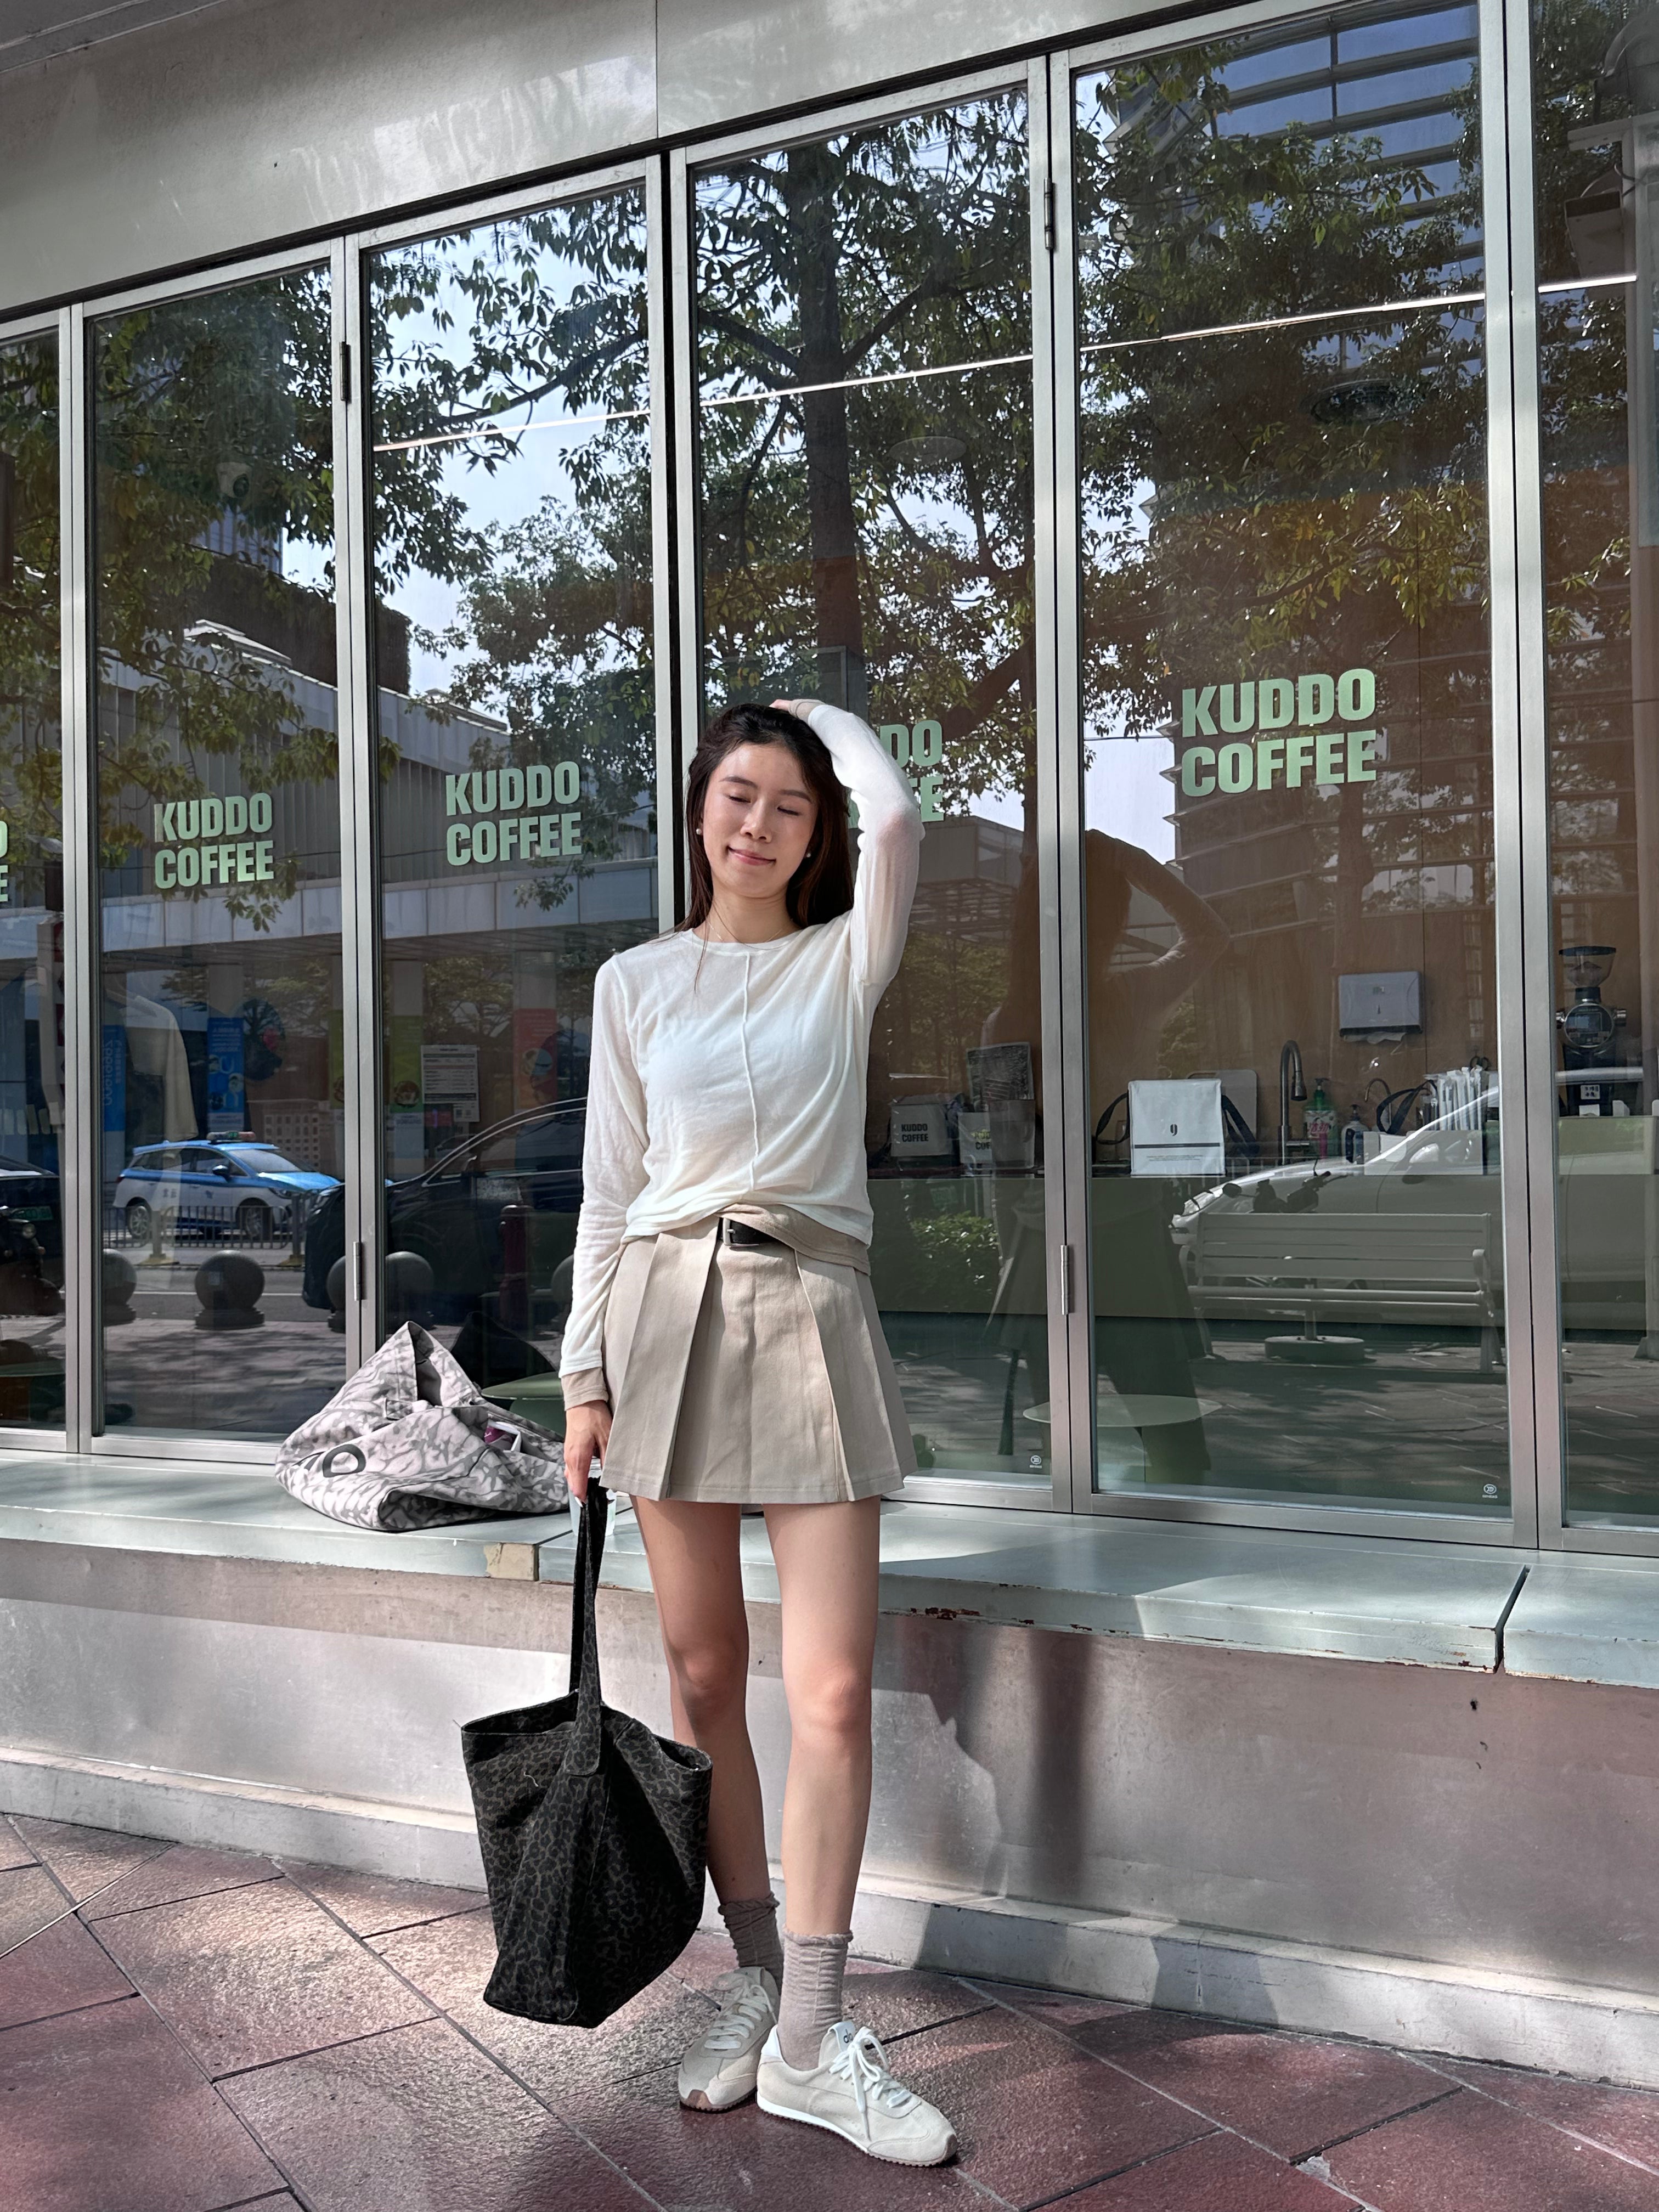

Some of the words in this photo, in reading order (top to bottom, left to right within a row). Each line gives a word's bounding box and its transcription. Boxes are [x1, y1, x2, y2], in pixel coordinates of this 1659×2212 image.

[1182, 668, 1376, 738] KUDDO
[445, 761, 580, 816] KUDDO
[1181, 730, 1377, 797] COFFEE
[154, 793, 273, 843] KUDDO
[446, 812, 582, 866] COFFEE
[155, 840, 274, 889] COFFEE
[901, 1123, 928, 1132] KUDDO
[902, 1133, 929, 1142] COFFEE
[975, 1142, 991, 1150] COF
